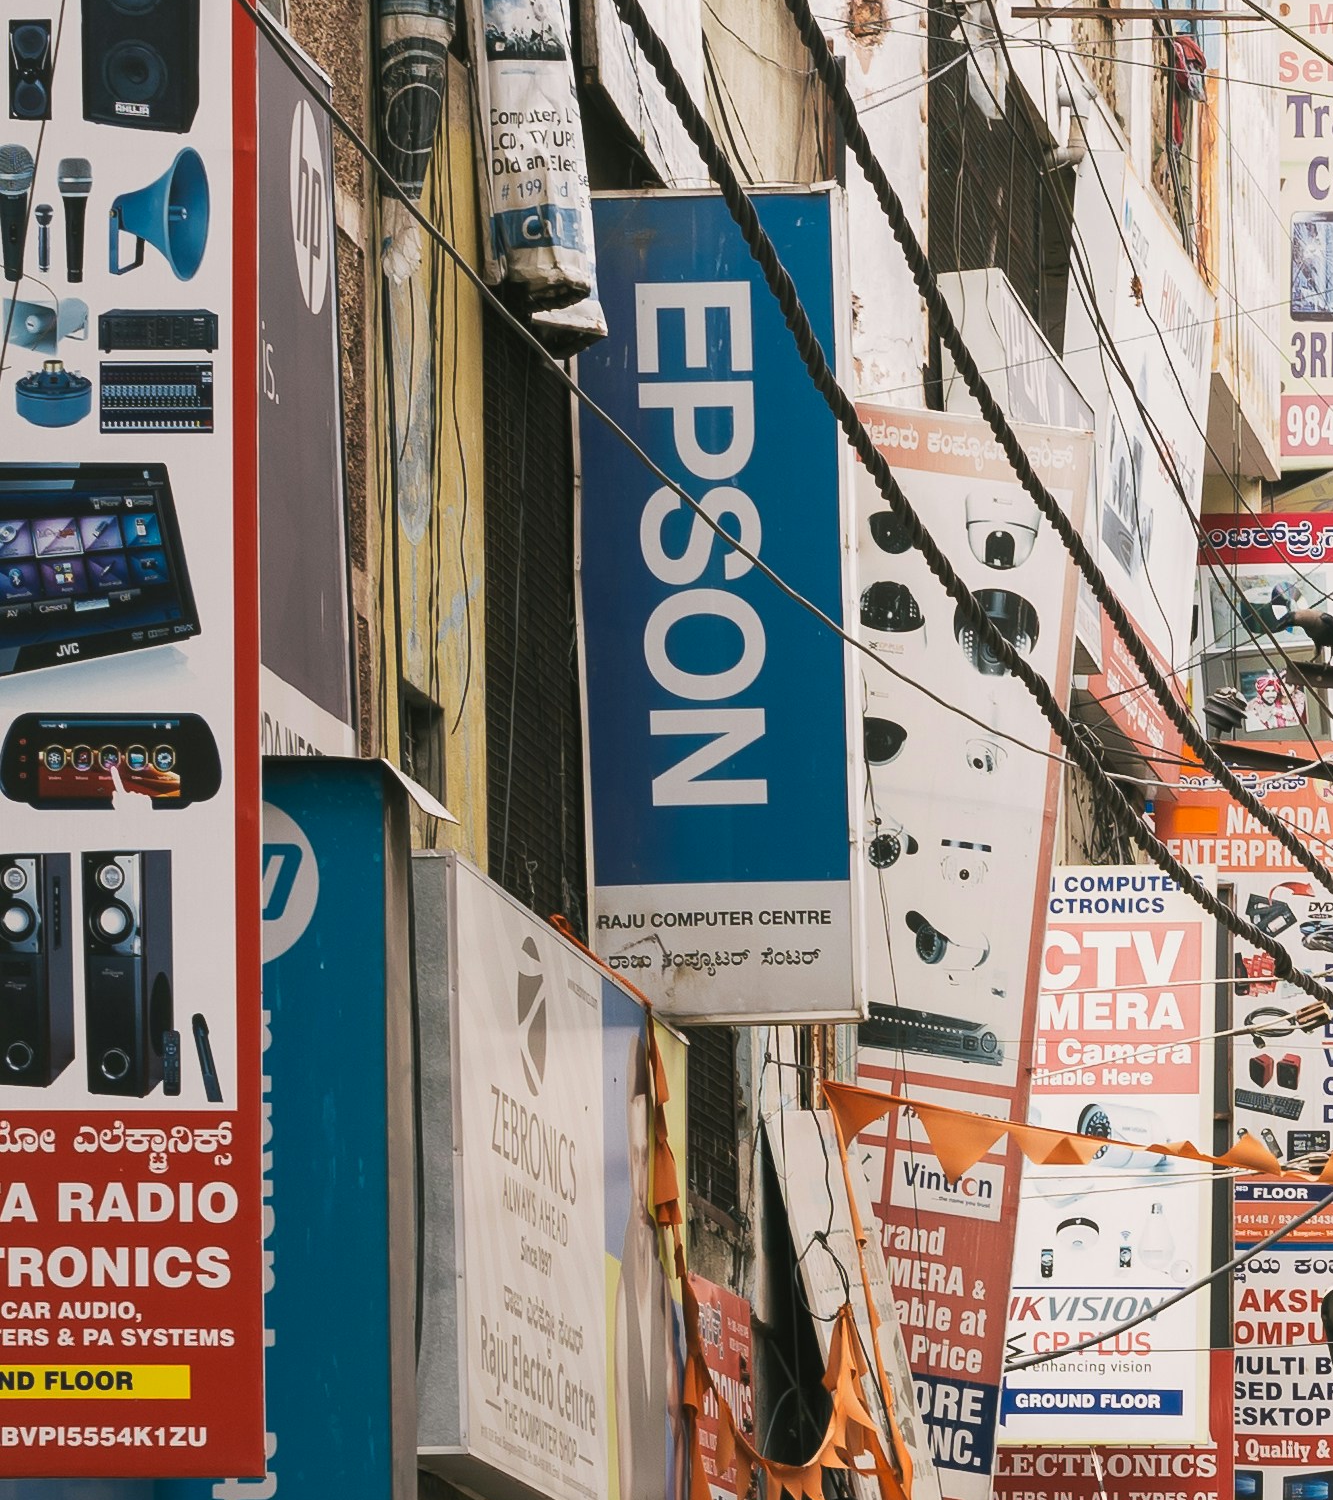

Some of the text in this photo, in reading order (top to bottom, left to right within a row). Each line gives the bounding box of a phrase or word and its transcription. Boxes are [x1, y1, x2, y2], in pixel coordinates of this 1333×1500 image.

[634, 281, 769, 806] EPSON
[598, 908, 832, 930] RAJU COMPUTER CENTRE
[1058, 1038, 1192, 1065] Camera
[1102, 1069, 1153, 1085] Here
[491, 1084, 577, 1205] ZEBRONICS
[58, 1182, 239, 1224] RADIO
[1253, 1188, 1308, 1199] FLOOR
[502, 1174, 568, 1247] ALWAYS AHEAD
[520, 1236, 552, 1278] Since 1997
[1, 1301, 143, 1323] CAR AUDIO,
[83, 1329, 235, 1347] PA SYSTEMS
[1033, 1332, 1151, 1355] CP PLUS
[911, 1334, 983, 1373] Price
[480, 1315, 596, 1435] Raju Electro Centre
[1033, 1361, 1151, 1375] enhancing vision
[45, 1371, 133, 1391] FLOOR
[1015, 1393, 1160, 1409] GROUND FLOOR
[504, 1399, 558, 1457] THE COMPUTER
[1246, 1443, 1311, 1462] Quality
